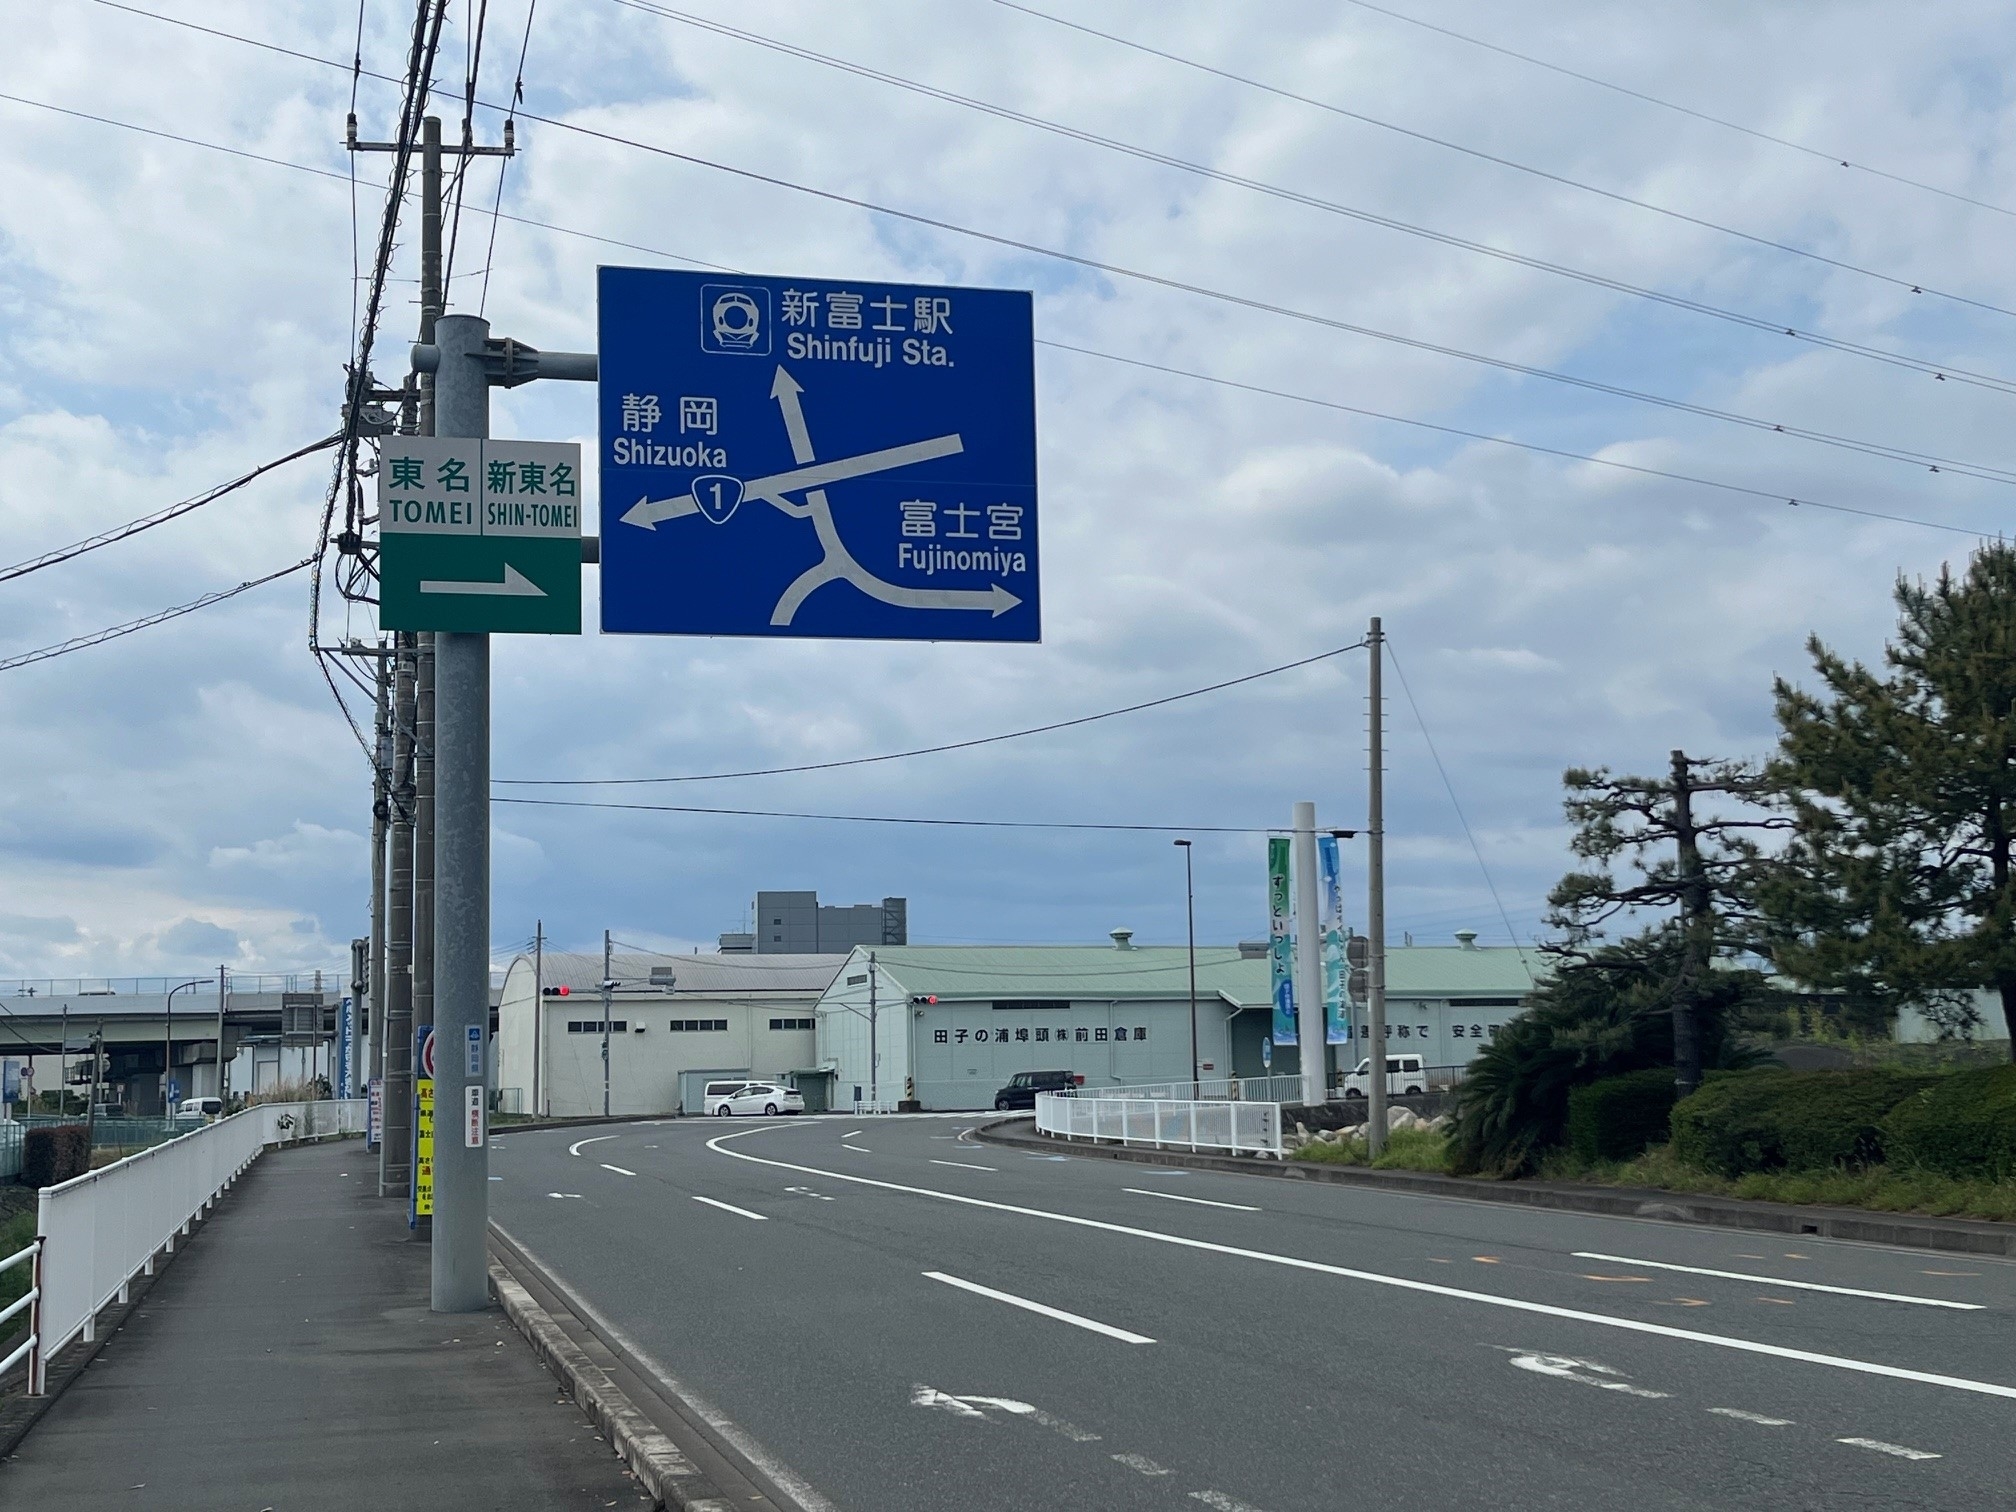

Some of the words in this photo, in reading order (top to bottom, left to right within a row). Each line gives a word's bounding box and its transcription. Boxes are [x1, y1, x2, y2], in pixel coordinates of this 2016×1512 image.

[781, 288, 954, 335] 新富士駅
[787, 333, 891, 368] Shinfuji
[902, 340, 955, 367] Sta.
[622, 393, 718, 435] 静岡
[613, 437, 727, 468] Shizuoka
[388, 456, 470, 493] 東名
[488, 460, 576, 496] 新東名
[389, 500, 472, 525] TOMEI
[708, 482, 722, 510] 1
[488, 503, 578, 528] SHIN-TOMEI
[899, 500, 1024, 541] 富士宮
[898, 543, 1026, 576] Fujinomiya
